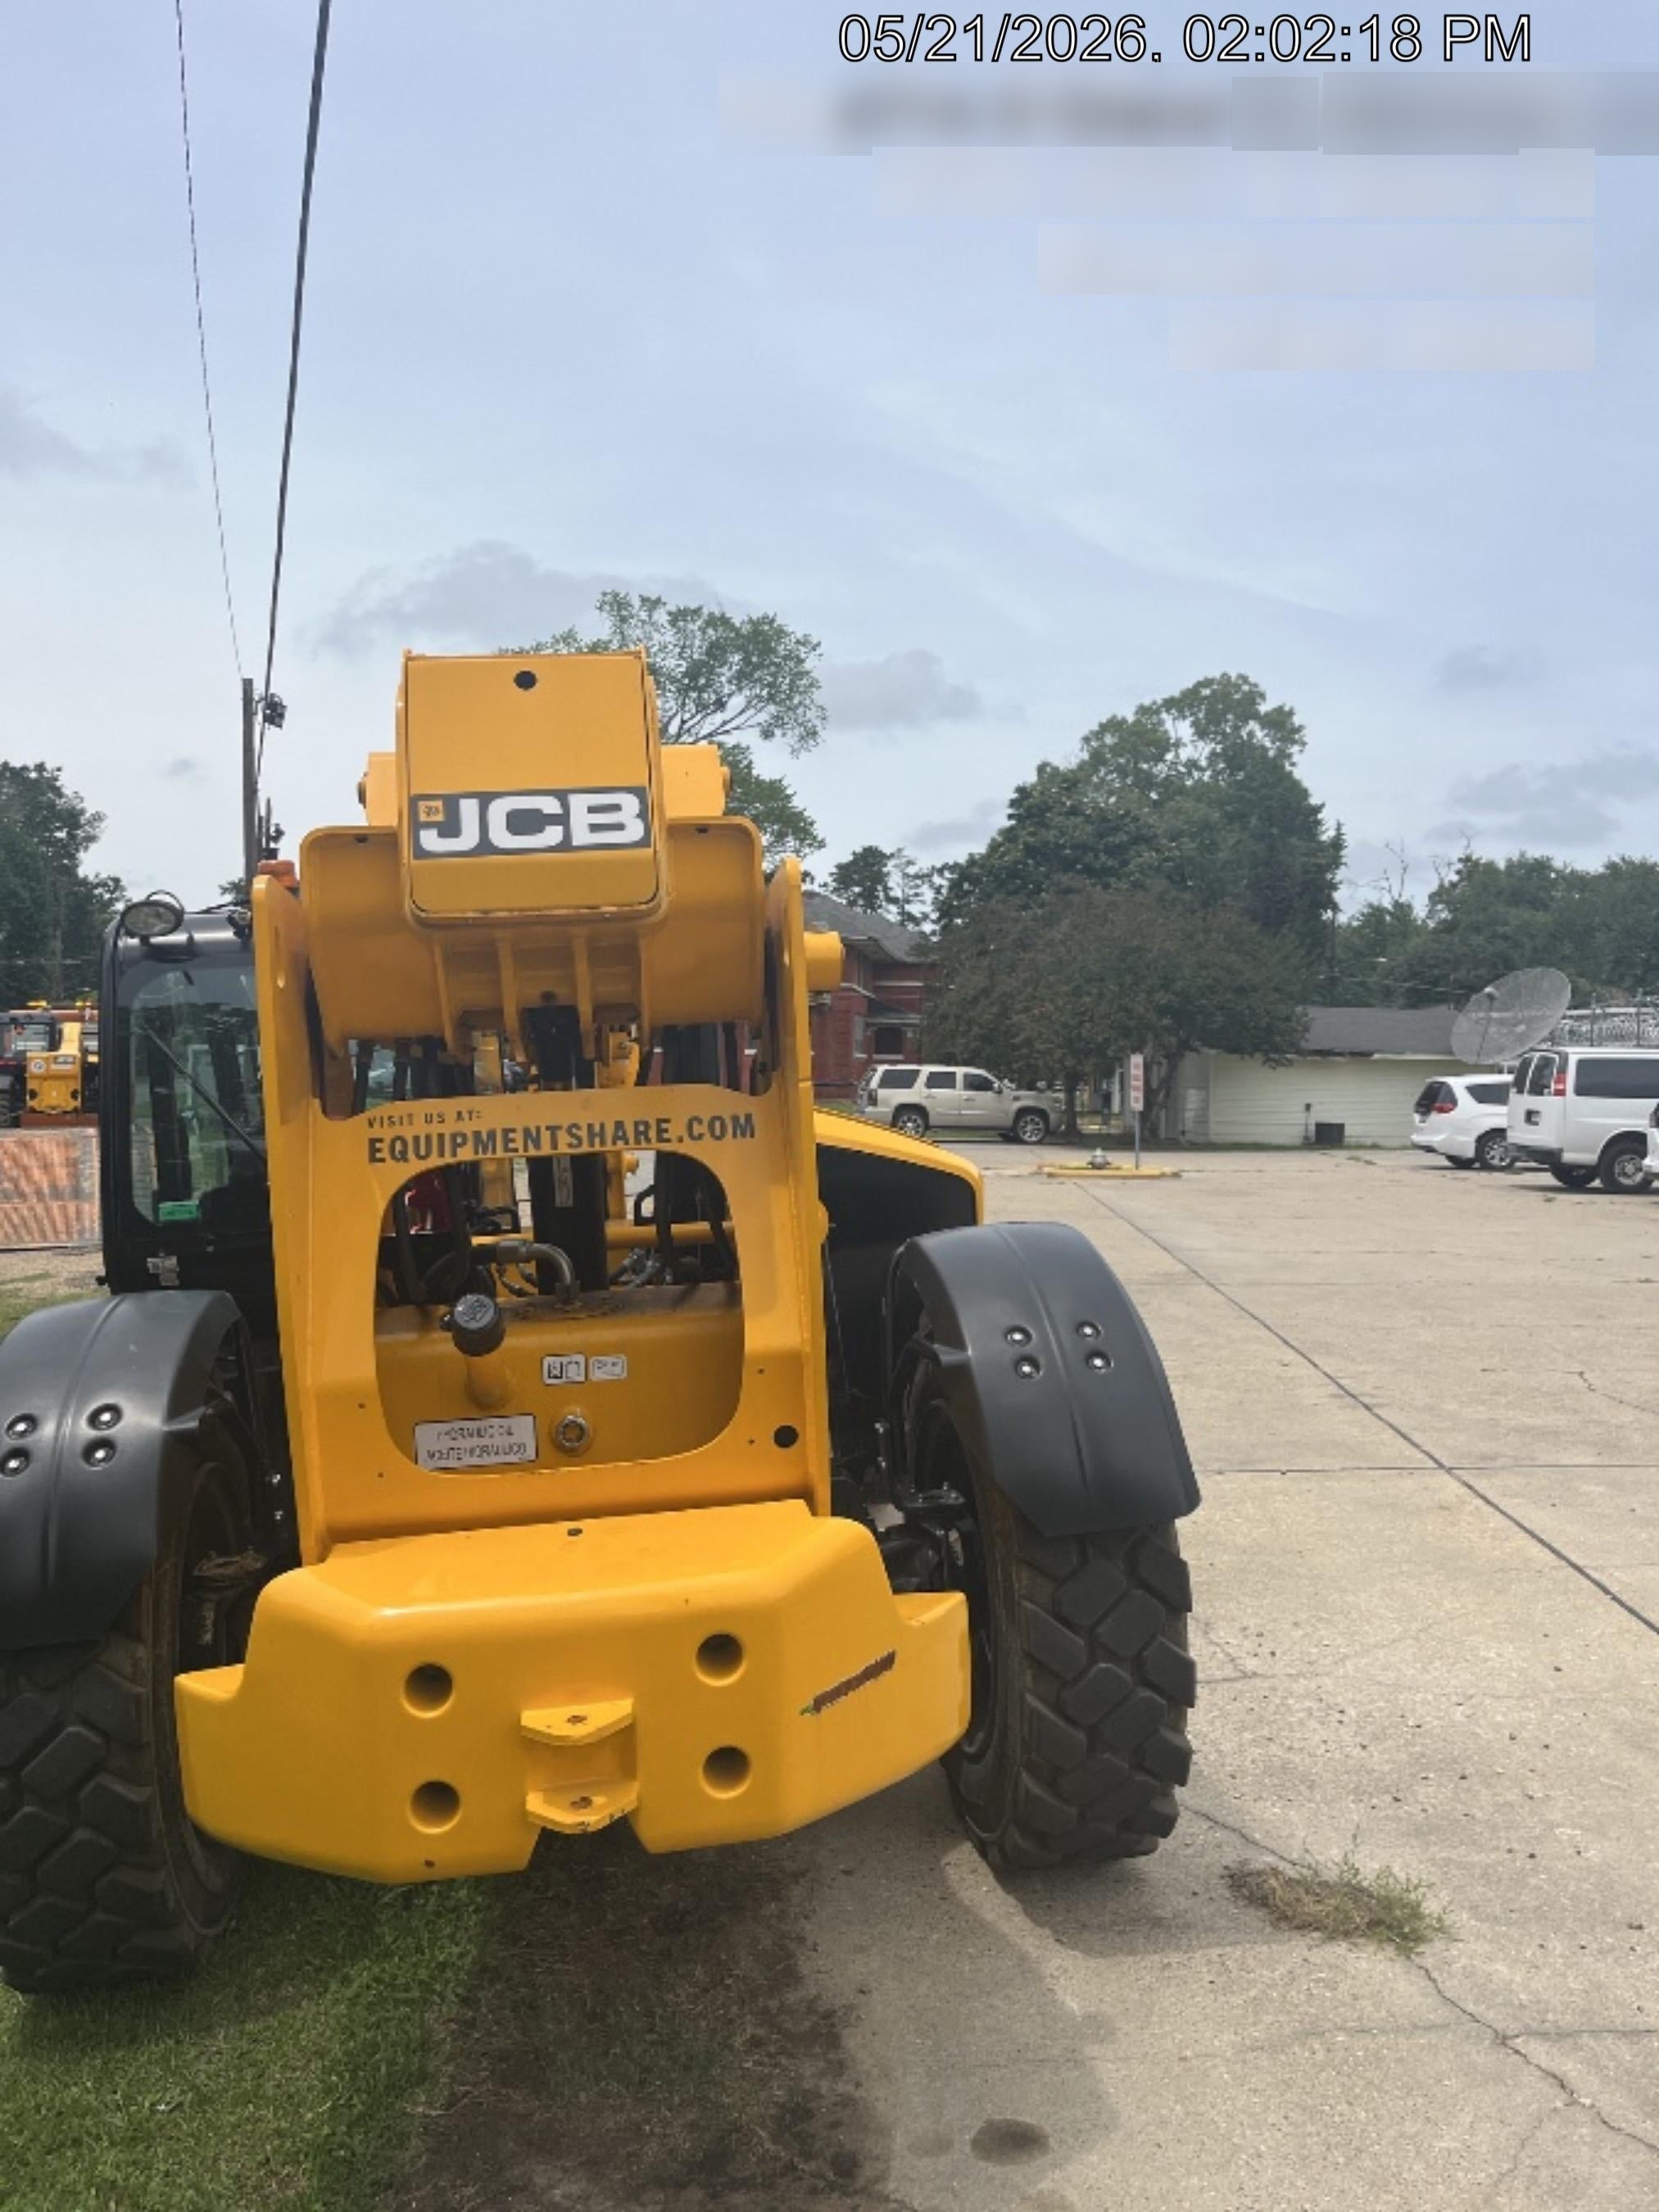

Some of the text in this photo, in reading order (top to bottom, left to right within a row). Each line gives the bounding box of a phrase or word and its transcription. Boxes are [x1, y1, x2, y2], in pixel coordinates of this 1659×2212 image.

[418, 791, 645, 853] JCB
[367, 1113, 415, 1129] VISIT
[424, 1112, 446, 1124] US
[367, 1113, 756, 1164] EQUIPMENTSHARE.COM
